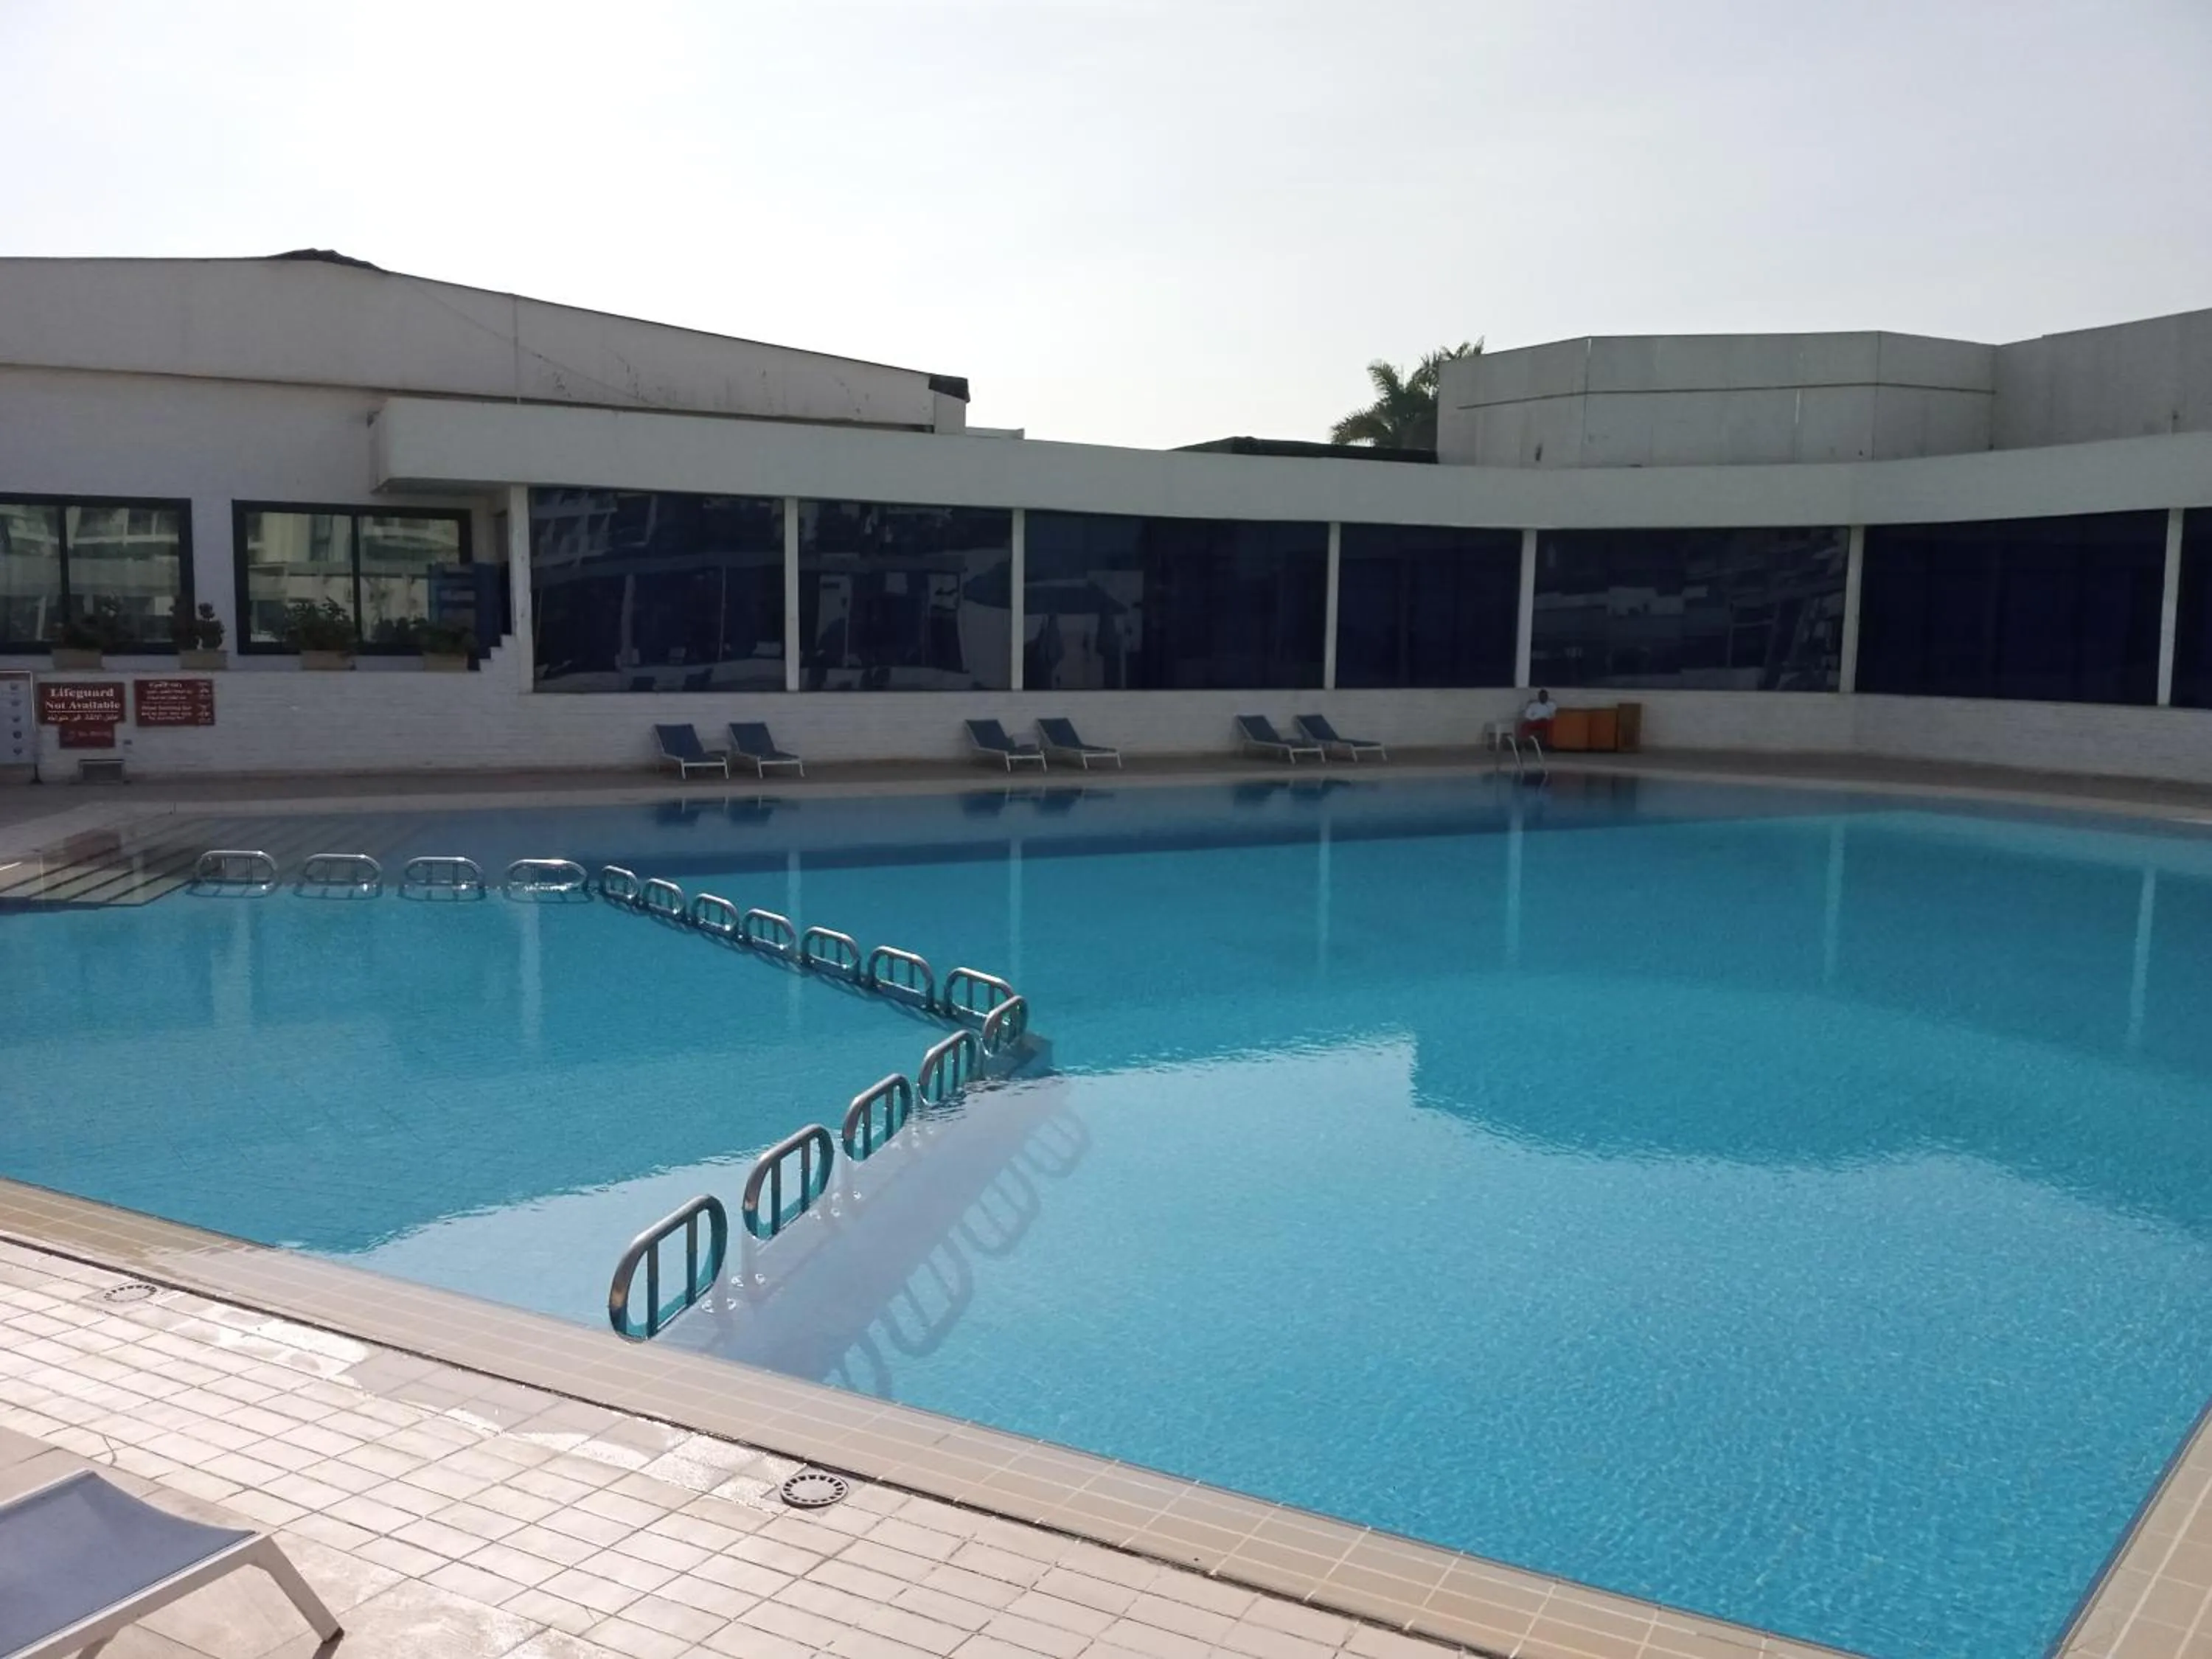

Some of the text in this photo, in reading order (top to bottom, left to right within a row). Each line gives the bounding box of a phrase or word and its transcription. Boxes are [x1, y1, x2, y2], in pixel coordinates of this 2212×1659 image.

[50, 687, 114, 700] Lifeguard
[46, 700, 120, 709] Not Available
